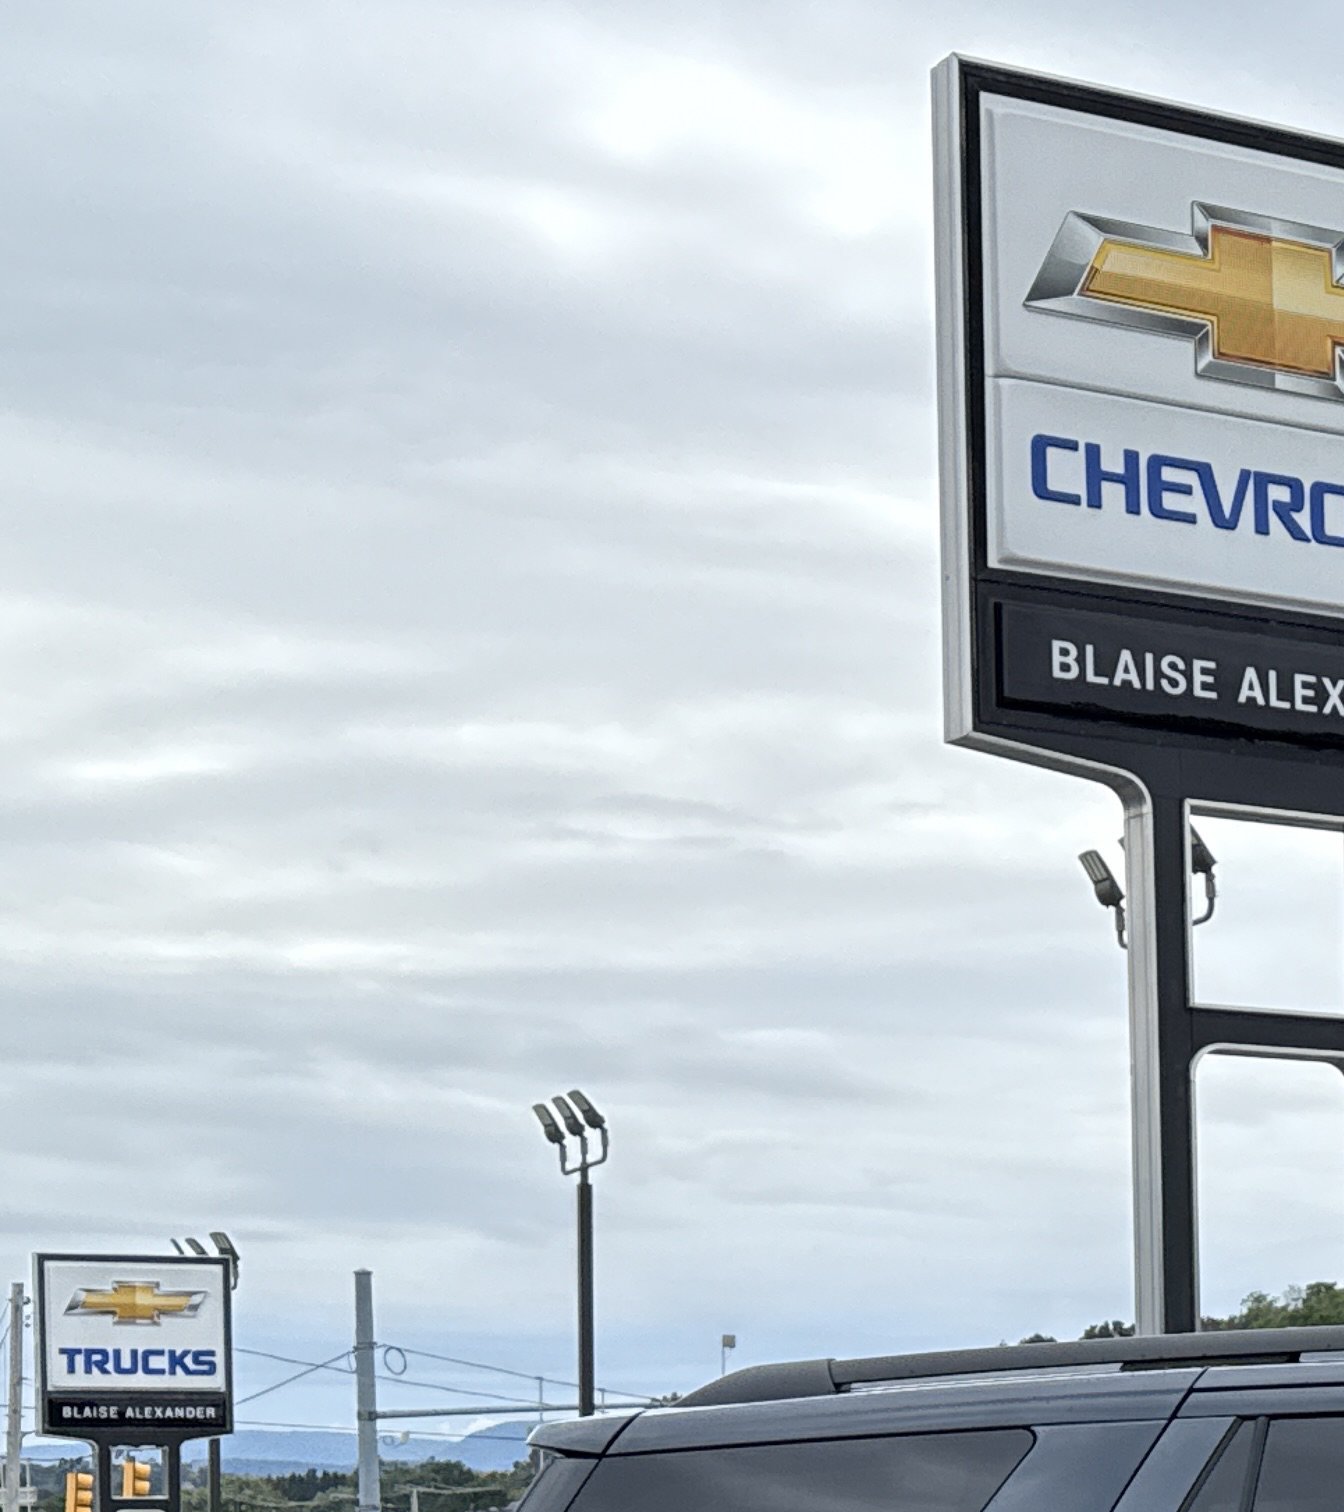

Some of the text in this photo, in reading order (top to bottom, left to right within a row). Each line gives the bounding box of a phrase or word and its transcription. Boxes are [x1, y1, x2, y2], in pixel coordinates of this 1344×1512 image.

[1051, 639, 1218, 700] BLAISE
[58, 1347, 217, 1376] TRUCKS
[62, 1405, 216, 1420] BLAISE ALEXANDER
